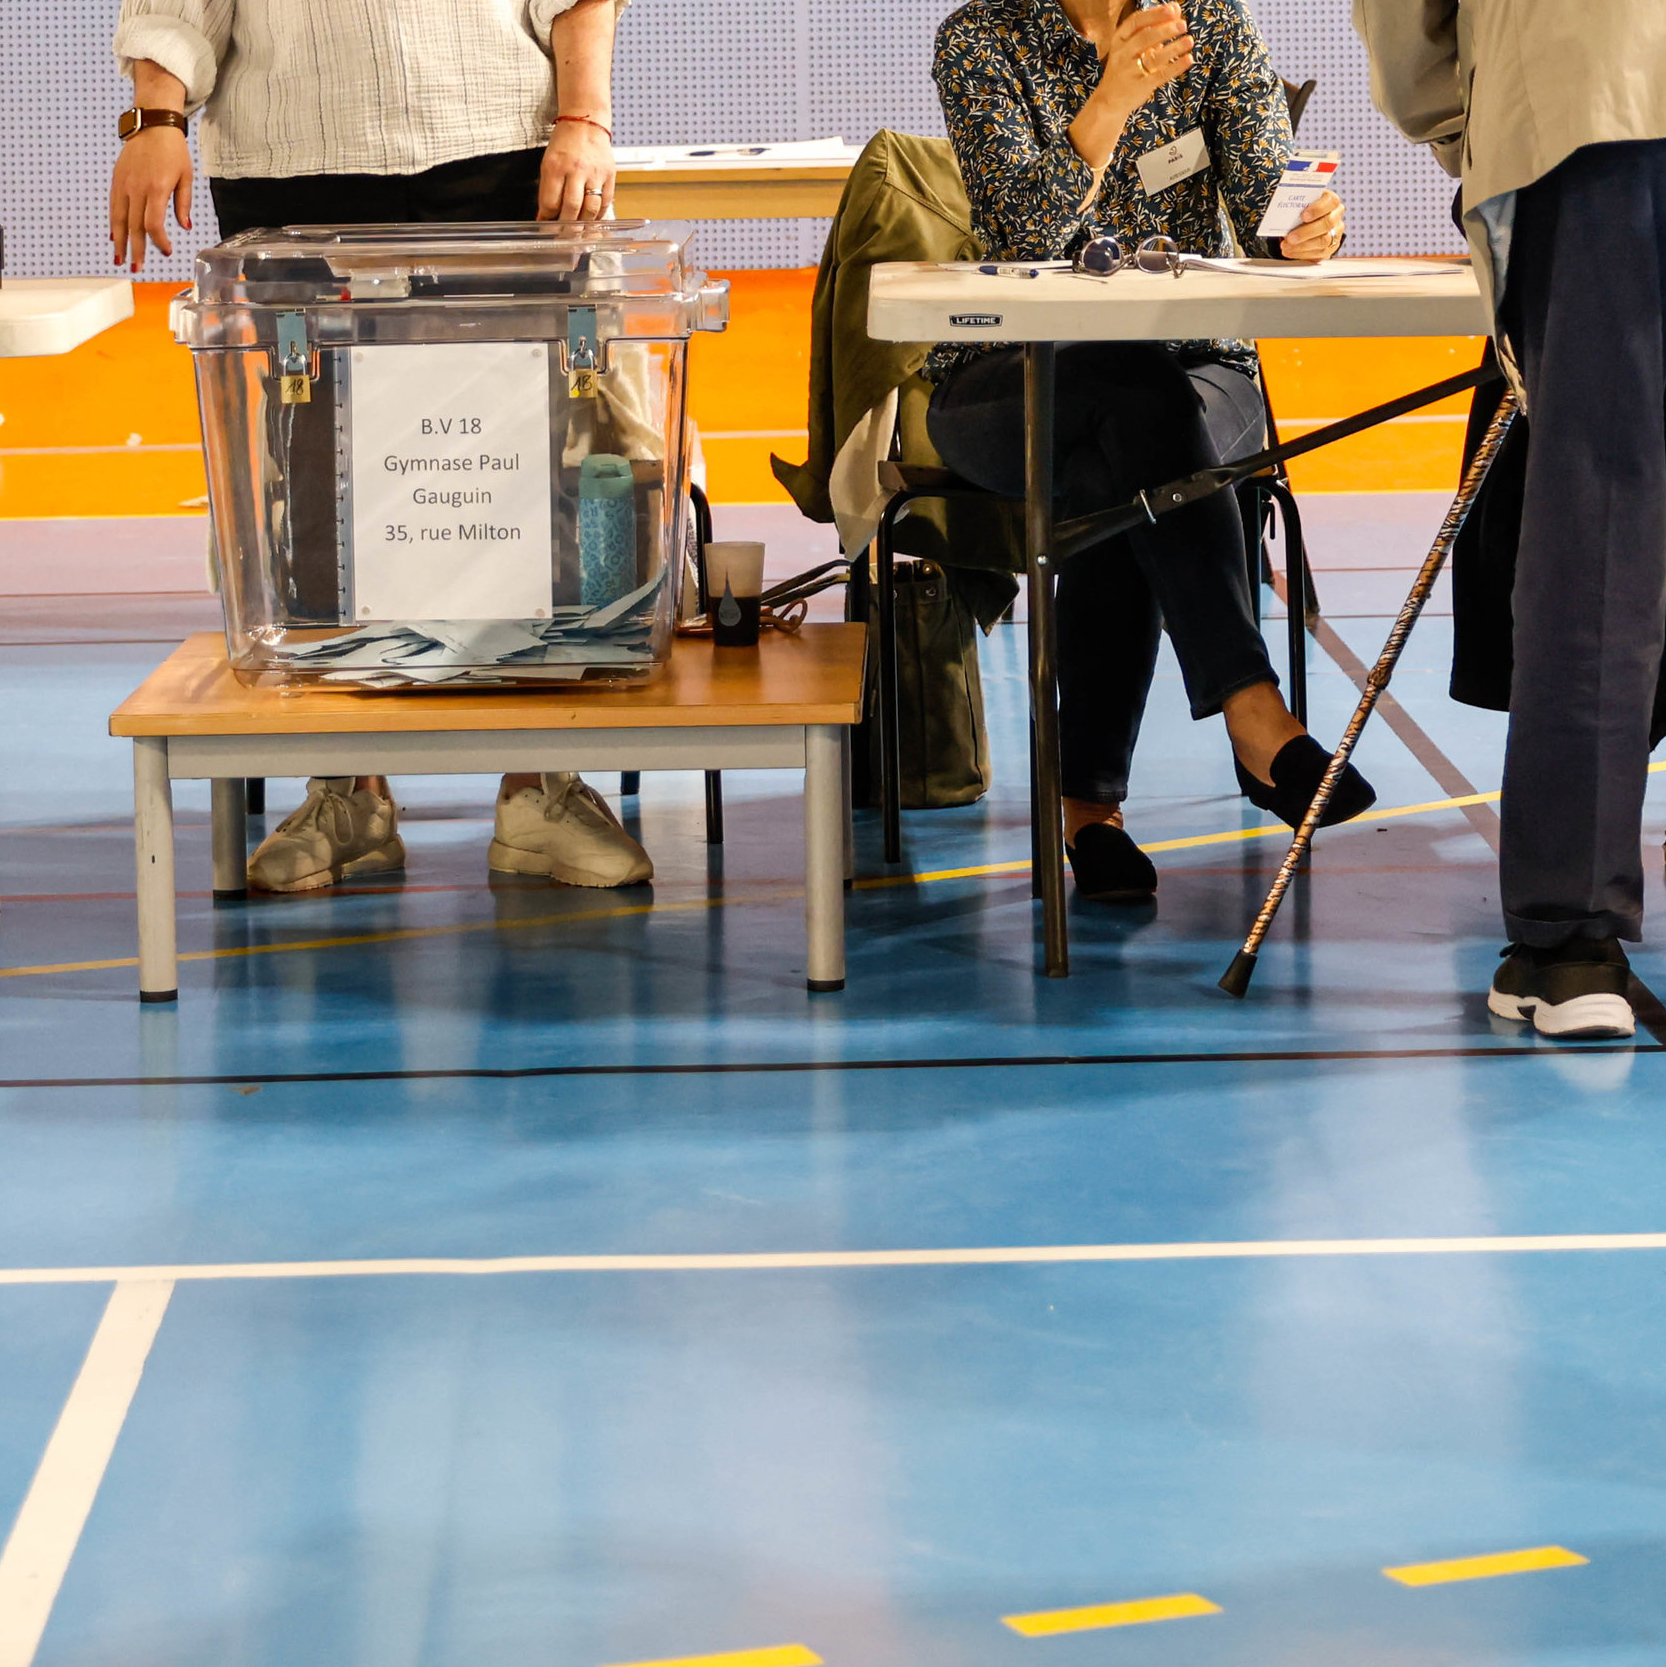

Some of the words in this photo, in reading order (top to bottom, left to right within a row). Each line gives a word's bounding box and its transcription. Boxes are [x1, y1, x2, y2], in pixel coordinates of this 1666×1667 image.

[1168, 153, 1183, 164] PARIS
[285, 378, 304, 395] 18
[571, 374, 593, 392] 18
[421, 418, 452, 434] B.V
[459, 418, 482, 434] 18
[384, 455, 473, 475] Gymnase
[479, 453, 519, 470] Paul
[413, 487, 492, 508] Gauguin
[385, 524, 414, 544] 35,
[421, 527, 452, 541] rue
[458, 523, 521, 541] Milton
